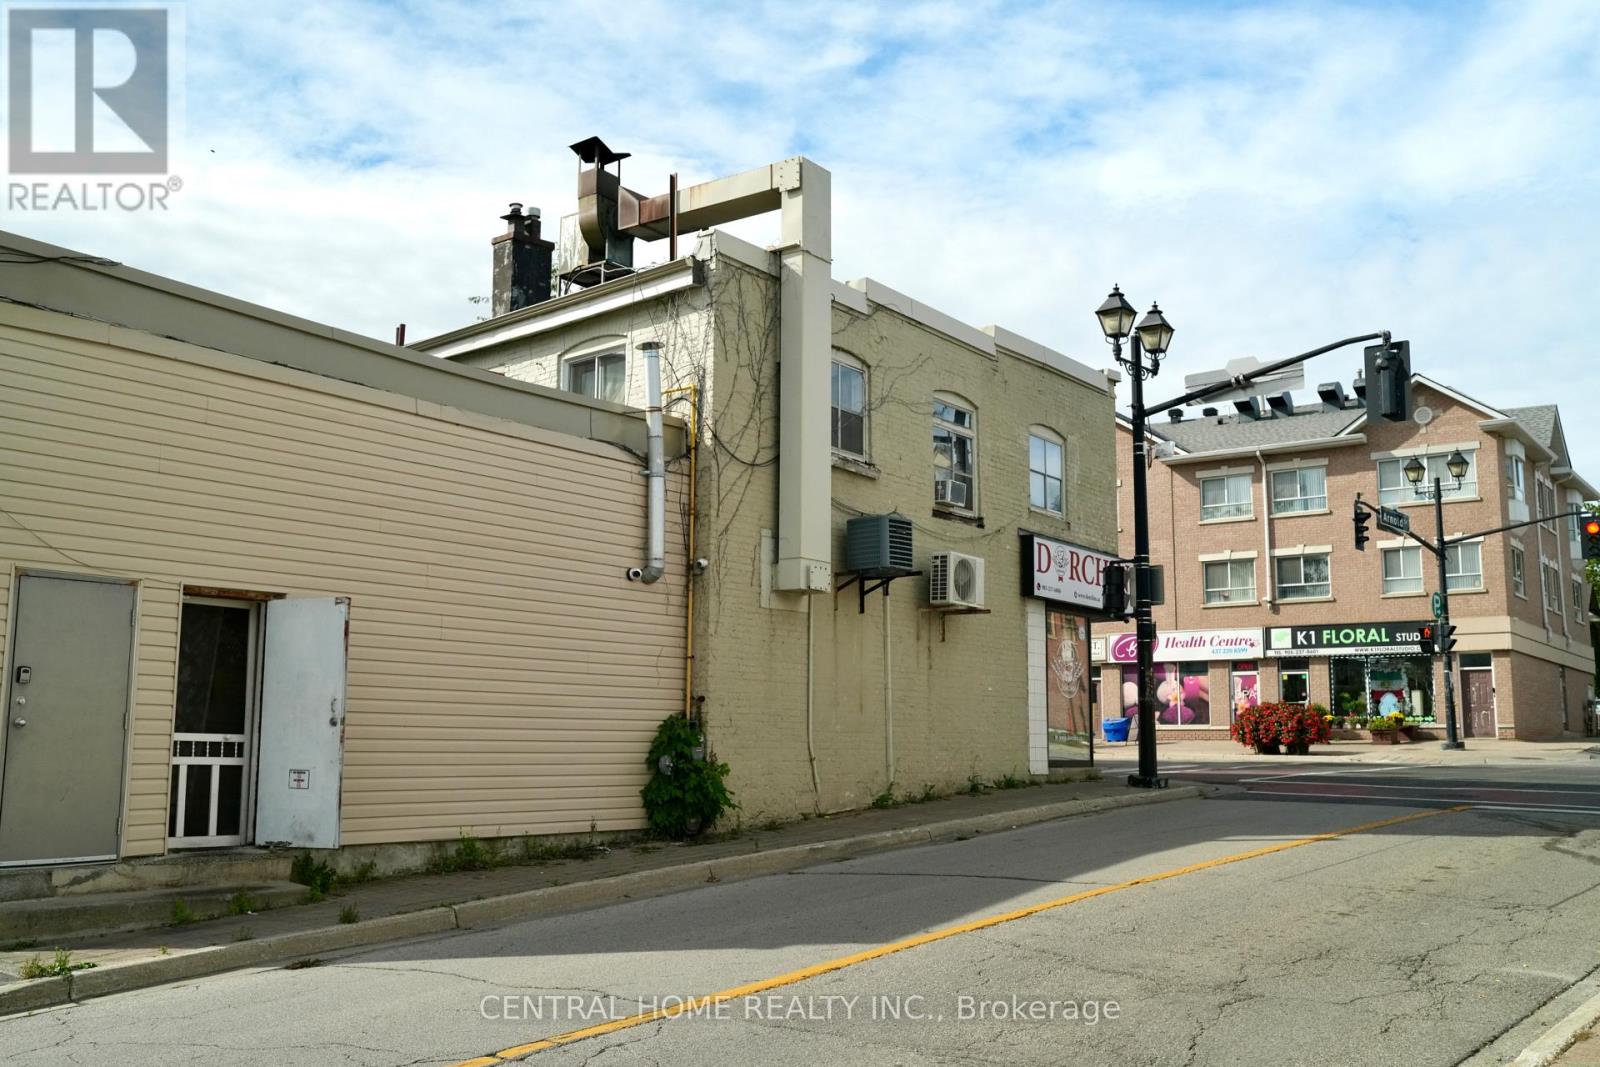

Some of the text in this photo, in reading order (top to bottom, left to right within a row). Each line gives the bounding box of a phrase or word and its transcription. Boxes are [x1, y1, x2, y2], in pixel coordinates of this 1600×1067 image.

[1165, 634, 1253, 649] Health Centre
[1296, 627, 1421, 646] K1 FLORAL STUD
